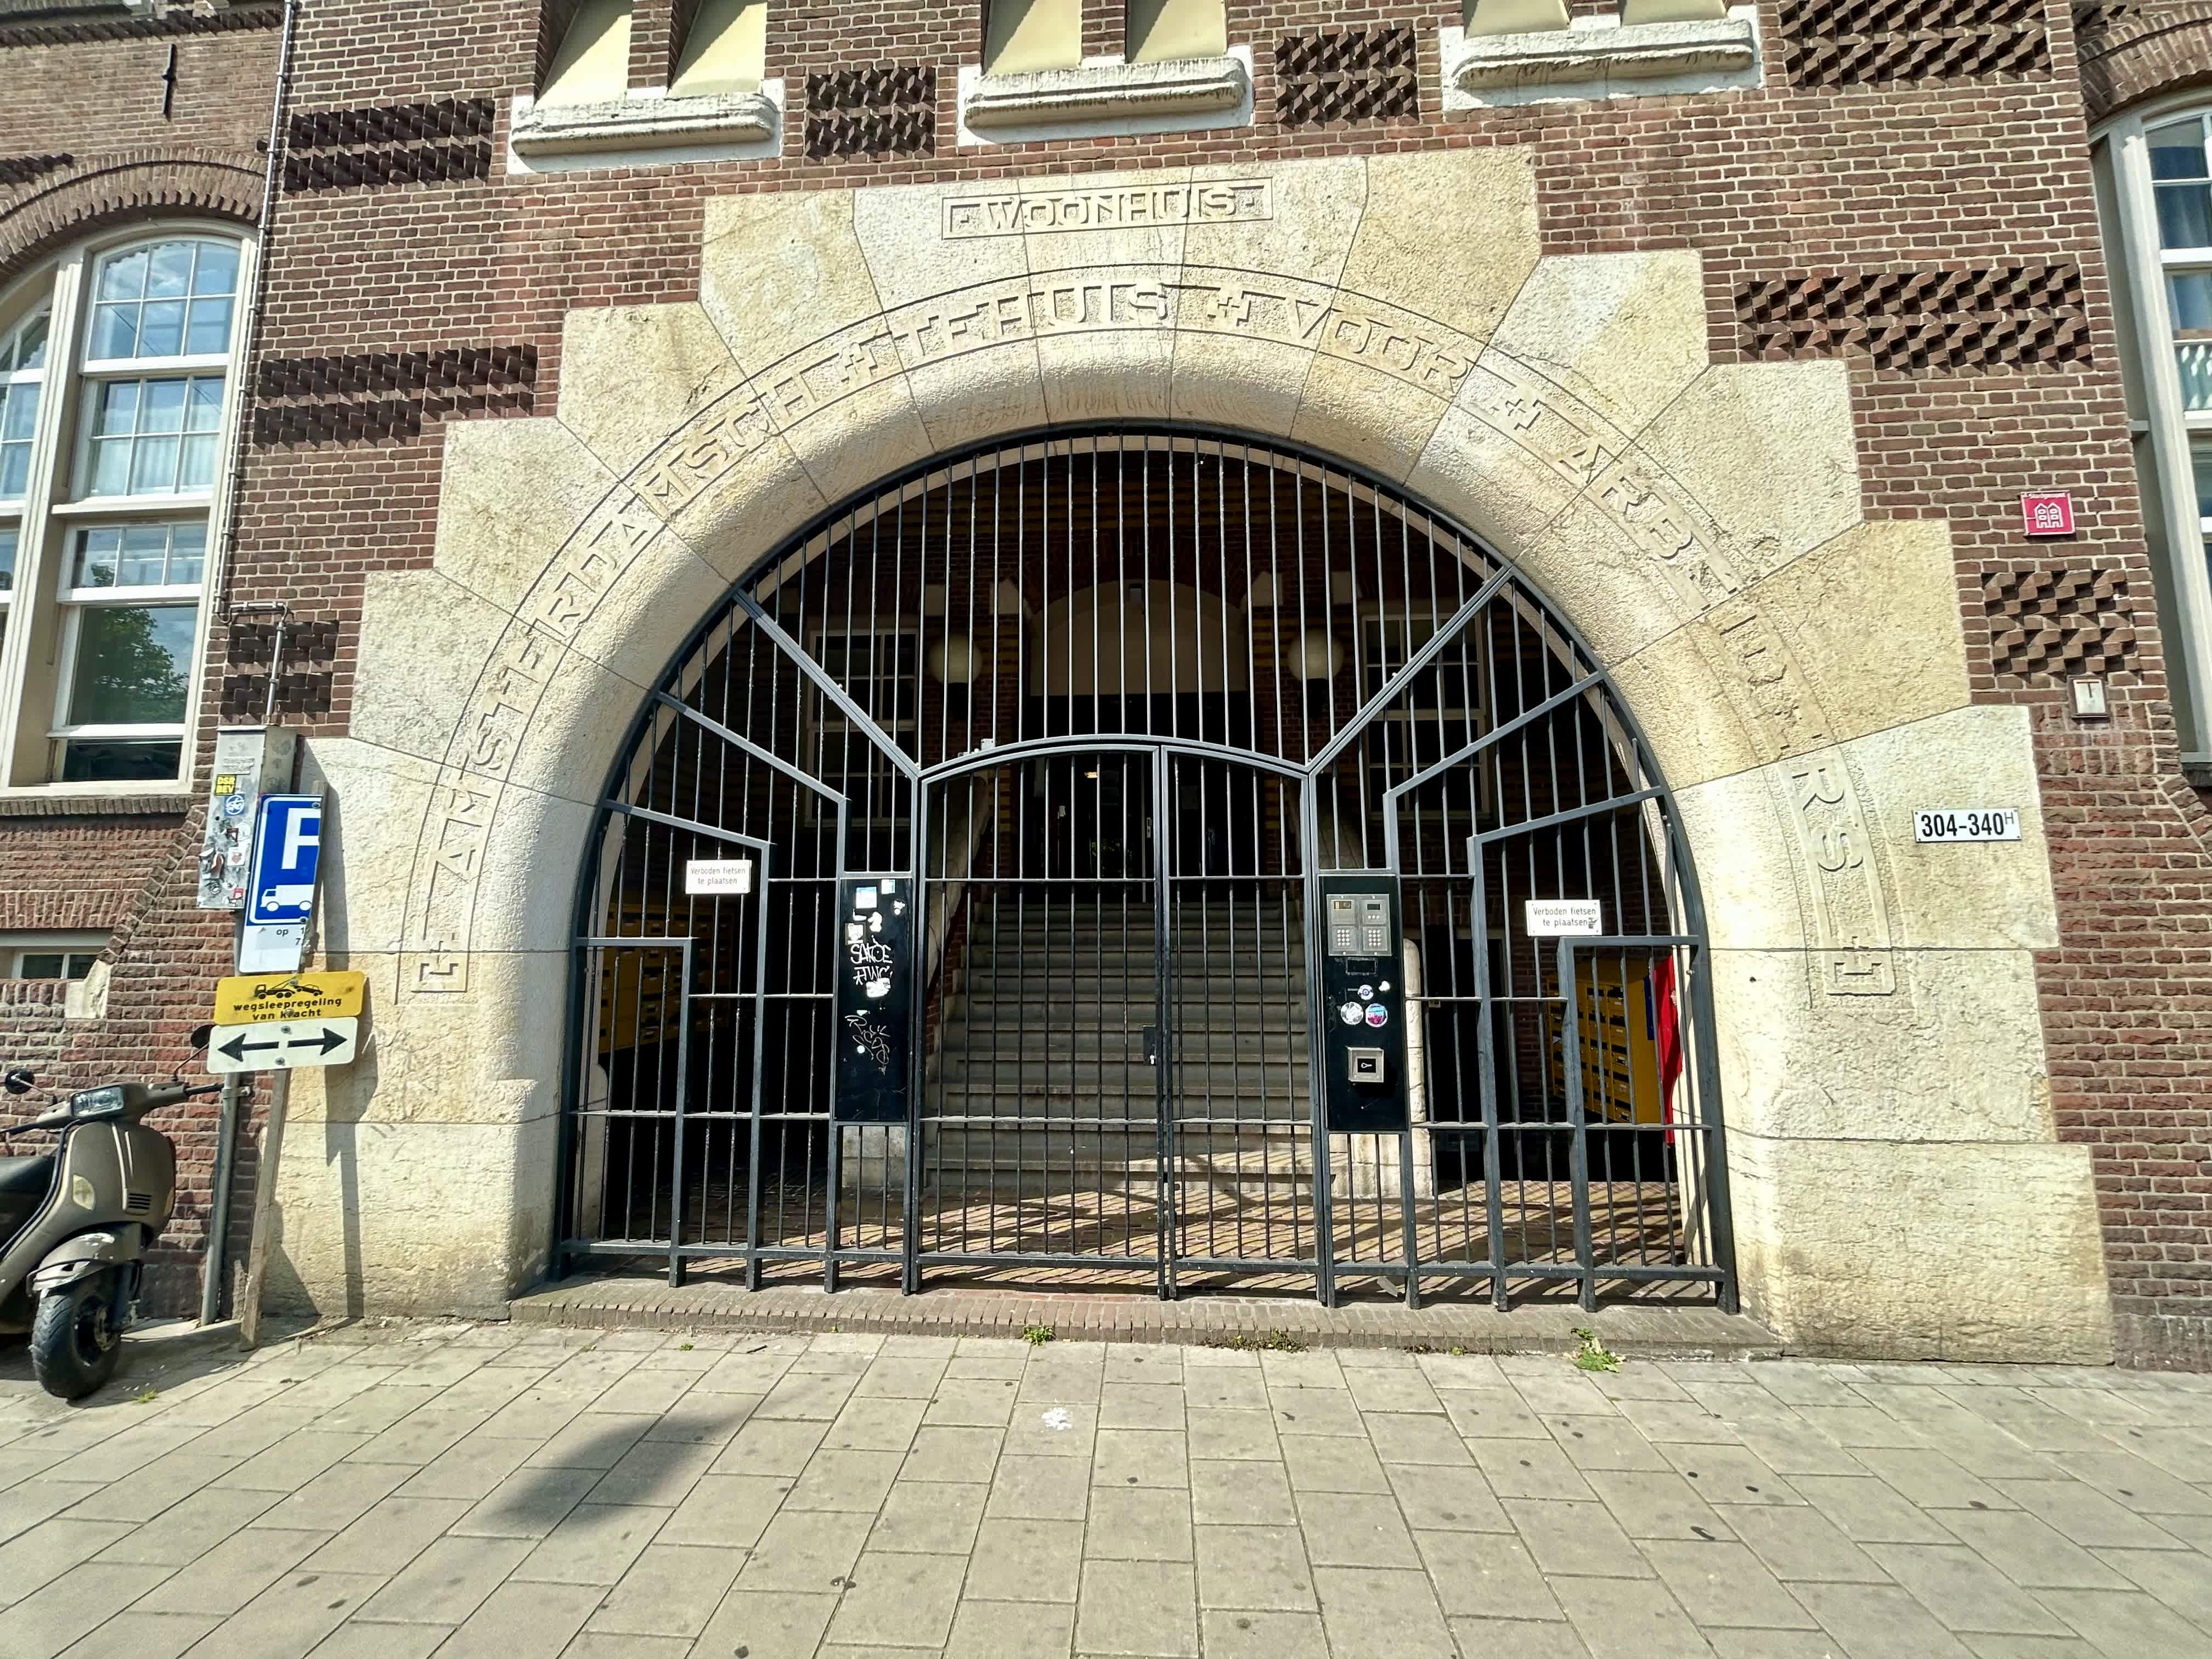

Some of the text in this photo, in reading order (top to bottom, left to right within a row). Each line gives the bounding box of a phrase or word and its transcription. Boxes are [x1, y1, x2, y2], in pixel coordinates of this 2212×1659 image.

[986, 186, 1238, 229] WOONHUIS
[435, 371, 820, 885] AMSTERDAMSCH
[892, 281, 1169, 357] TEHUIS
[1286, 297, 1469, 396] VOOR
[708, 877, 737, 886] plaatsen
[1533, 907, 1596, 916] Verboden fietsen
[1554, 918, 1588, 928] plaatsen
[276, 929, 289, 937] op
[233, 998, 342, 1012] wegsleepregeling
[280, 1008, 321, 1019] kacht
